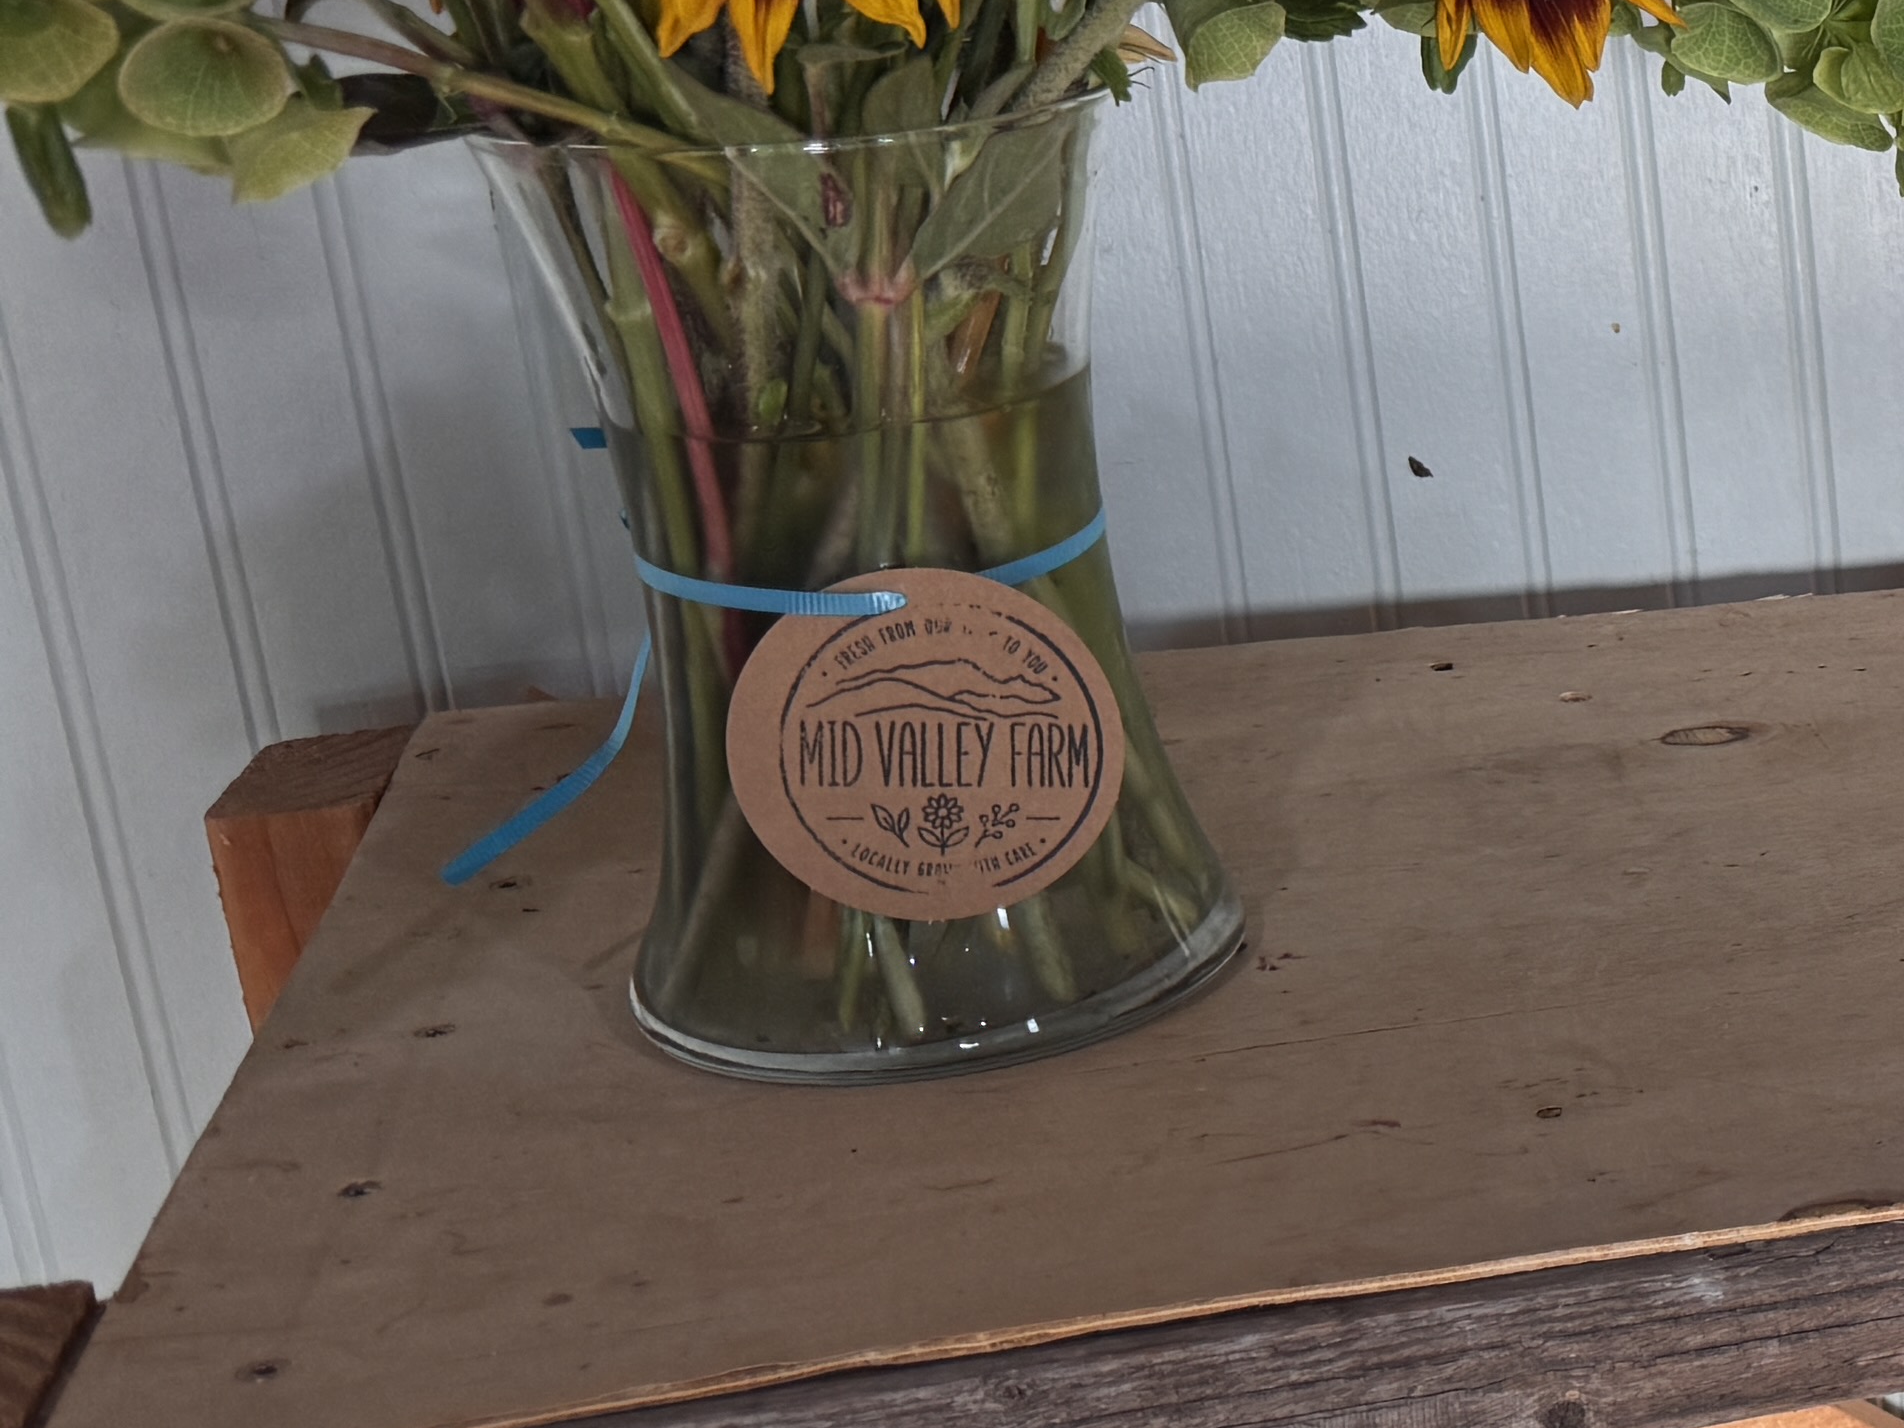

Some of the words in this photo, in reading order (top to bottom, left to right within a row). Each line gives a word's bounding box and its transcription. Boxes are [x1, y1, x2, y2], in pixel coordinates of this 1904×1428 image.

[834, 633, 877, 670] FRESH
[879, 619, 916, 645] FROM
[1002, 635, 1022, 653] TO
[1025, 649, 1049, 674] YOU
[800, 720, 863, 787] MID
[875, 720, 995, 788] VALLEY
[1009, 722, 1091, 789] FARM
[851, 842, 911, 875] LOCALLY
[974, 855, 1001, 874] ITH
[1004, 843, 1037, 866] CARE
